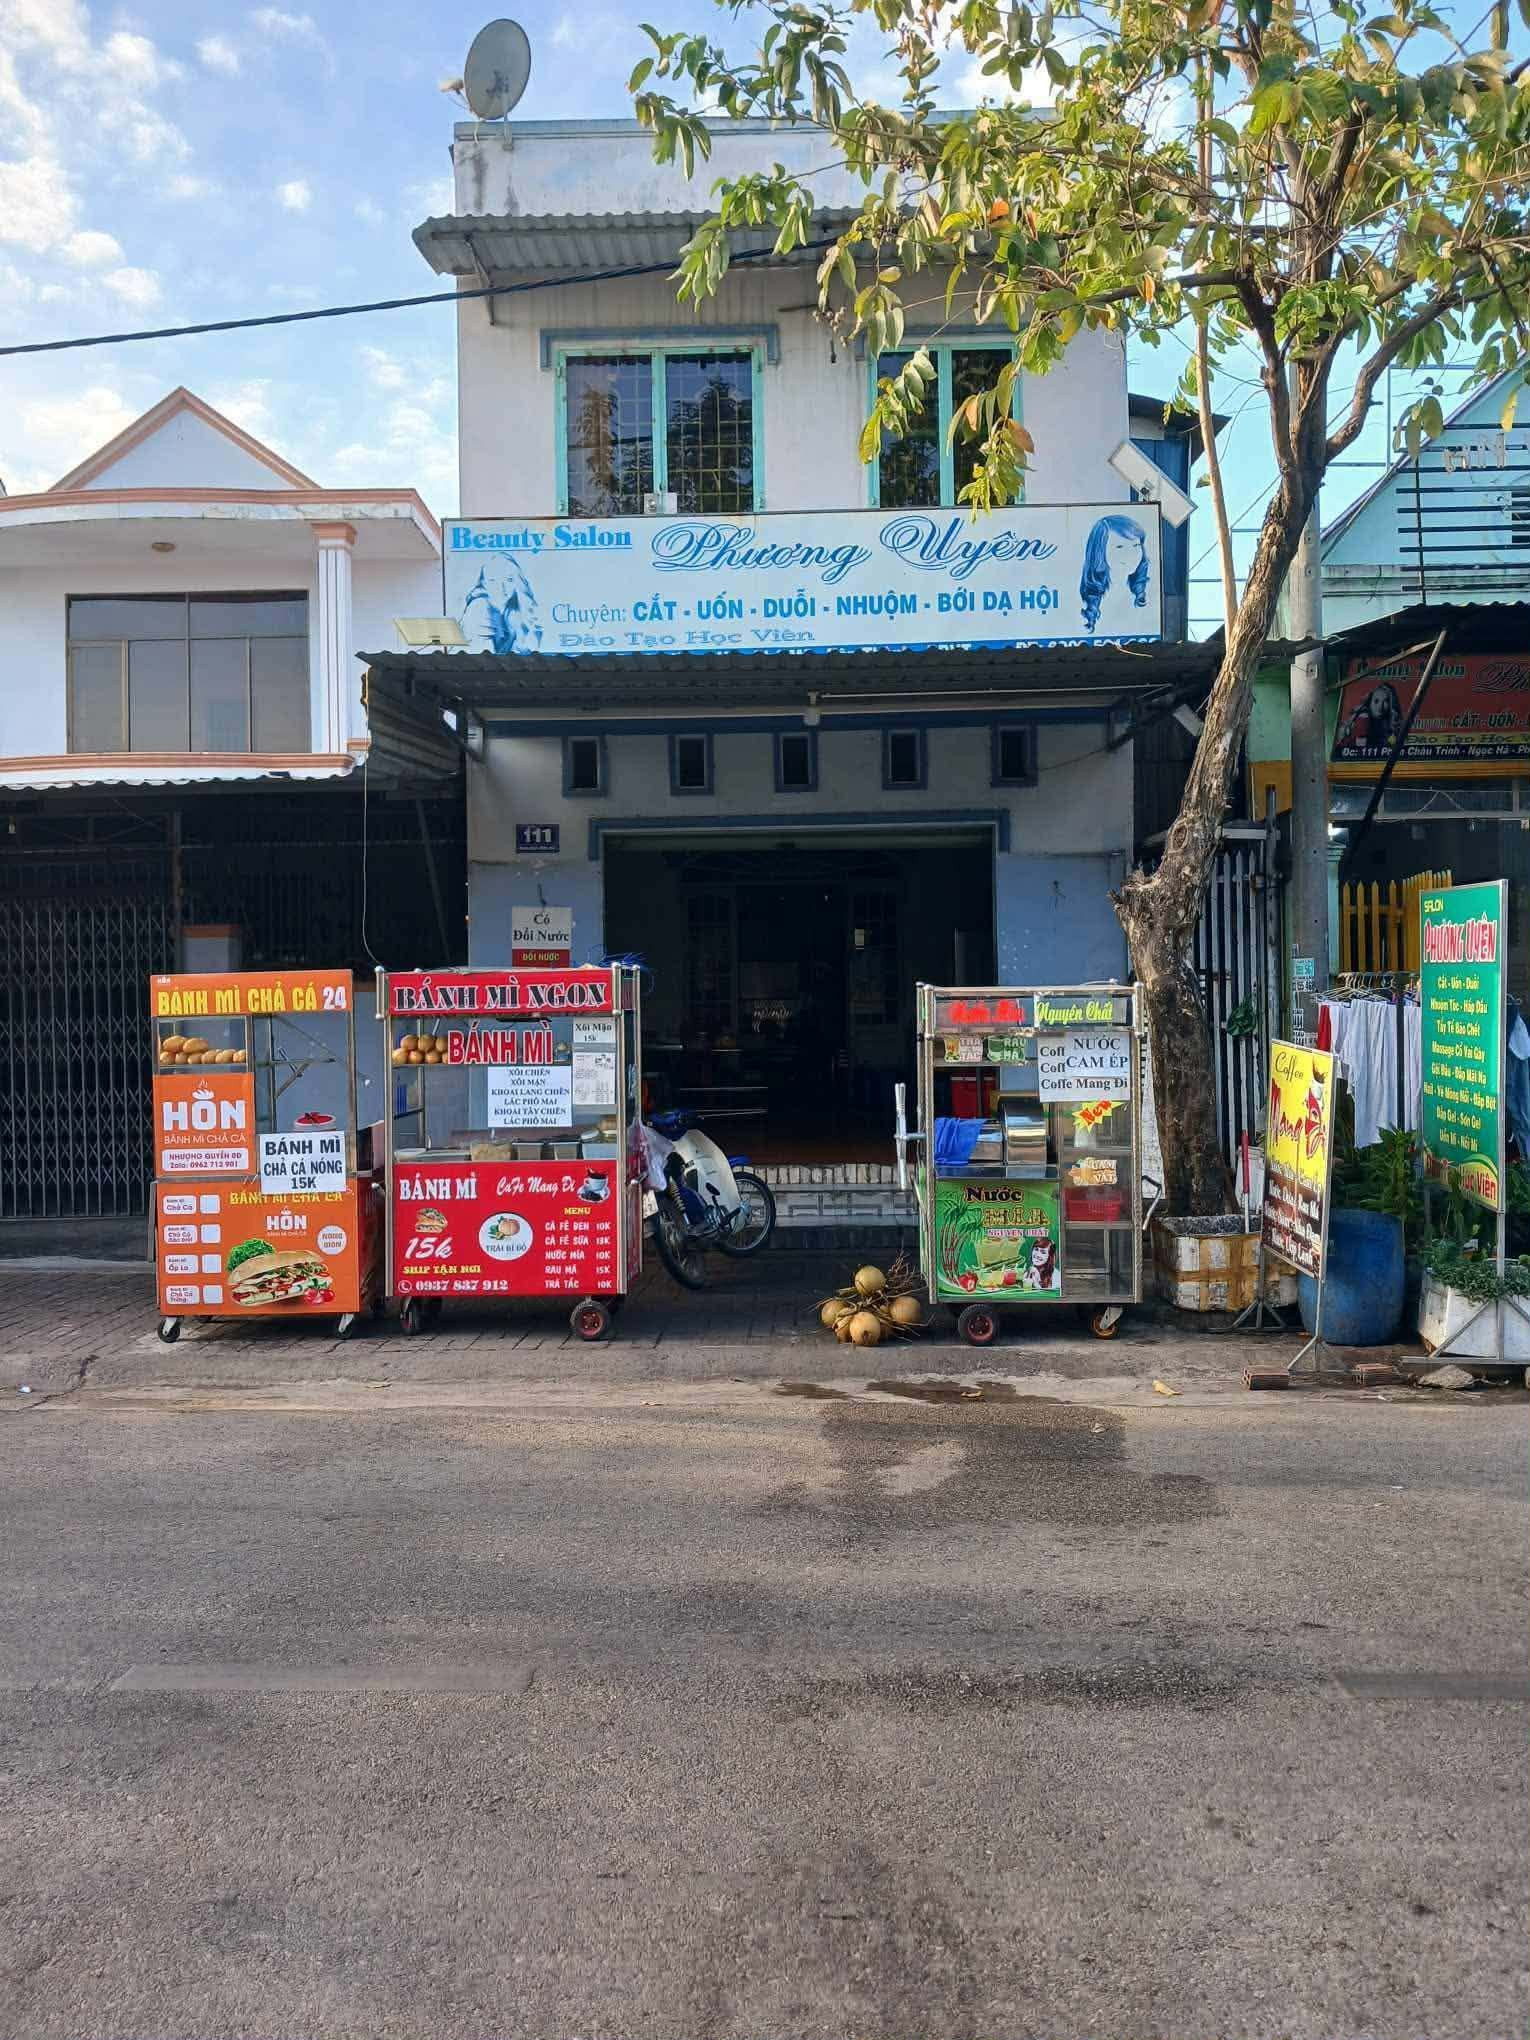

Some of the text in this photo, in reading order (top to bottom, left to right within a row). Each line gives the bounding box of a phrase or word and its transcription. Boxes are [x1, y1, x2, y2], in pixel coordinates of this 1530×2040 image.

[451, 524, 633, 555] Beauty Salon
[651, 515, 1058, 585] Phương Uyên
[633, 592, 677, 622] CẮT
[697, 590, 743, 620] UỐN
[763, 588, 816, 618] DUỖI
[836, 590, 918, 620] NHUỘM
[983, 591, 1012, 616] DẠ
[1020, 584, 1059, 615] HỘI
[624, 631, 676, 648] Tạo
[685, 630, 743, 646] Học
[523, 826, 552, 843] 111
[158, 986, 208, 1016] BÁNH
[215, 985, 241, 1014] MÌ
[247, 981, 287, 1014] CHẢ
[292, 982, 317, 1011] CÁ
[394, 976, 606, 1011] BÁNH MÌ NGON
[1037, 1001, 1083, 1025] Nguyên
[447, 1019, 554, 1065] BÁNH MÌ
[1073, 1032, 1121, 1050] NƯỚC
[1066, 1052, 1129, 1068] CAM ÉP
[1076, 1078, 1111, 1091] Mang
[1114, 1077, 1128, 1089] Đi
[265, 1135, 341, 1156] BÁNH MÌ
[263, 1157, 343, 1177] CHẢ CÁ NÓNG
[291, 1176, 317, 1190] 15K
[399, 1172, 451, 1201] BÁNH
[965, 1184, 1024, 1203] Nước
[563, 1207, 591, 1216] MENU
